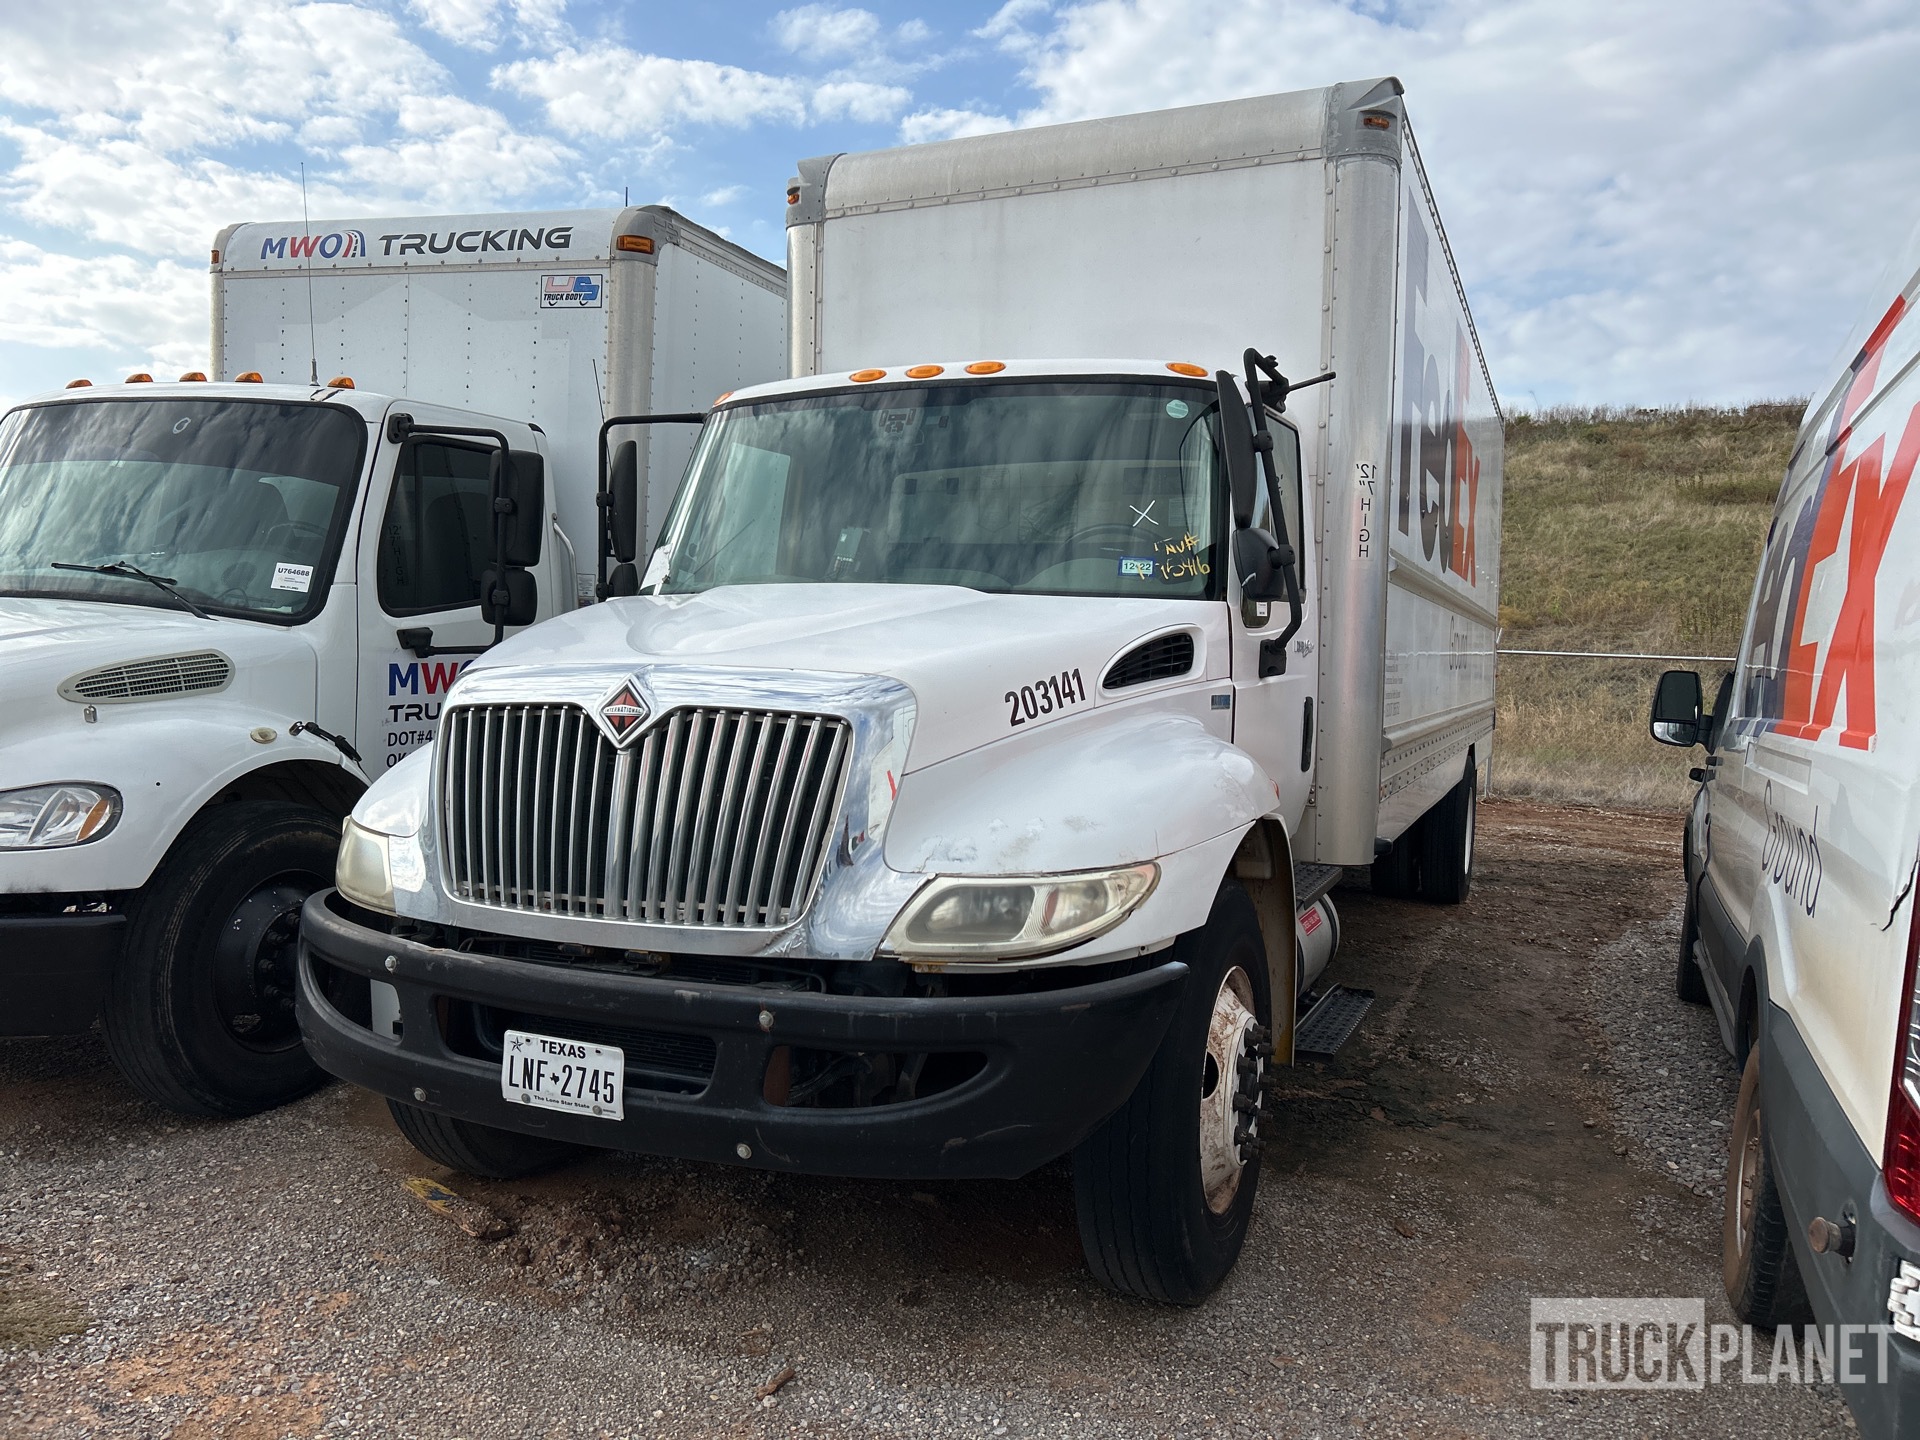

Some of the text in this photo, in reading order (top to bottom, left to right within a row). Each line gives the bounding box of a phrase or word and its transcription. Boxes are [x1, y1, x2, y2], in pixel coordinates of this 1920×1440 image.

[260, 226, 574, 260] MWO TRUCKING
[543, 293, 583, 301] TRUCK BODY
[545, 276, 600, 301] US
[1398, 185, 1481, 588] FedEx
[277, 567, 310, 577] U764688
[389, 660, 475, 696] MW
[1004, 668, 1086, 727] 203141
[388, 730, 436, 747] DOT#4
[1762, 779, 1822, 918] Ground
[540, 1039, 586, 1059] TEXAS
[560, 1064, 615, 1104] 2745
[546, 1096, 560, 1104] Lone
[560, 1098, 573, 1106] Star
[574, 1101, 590, 1109] State
